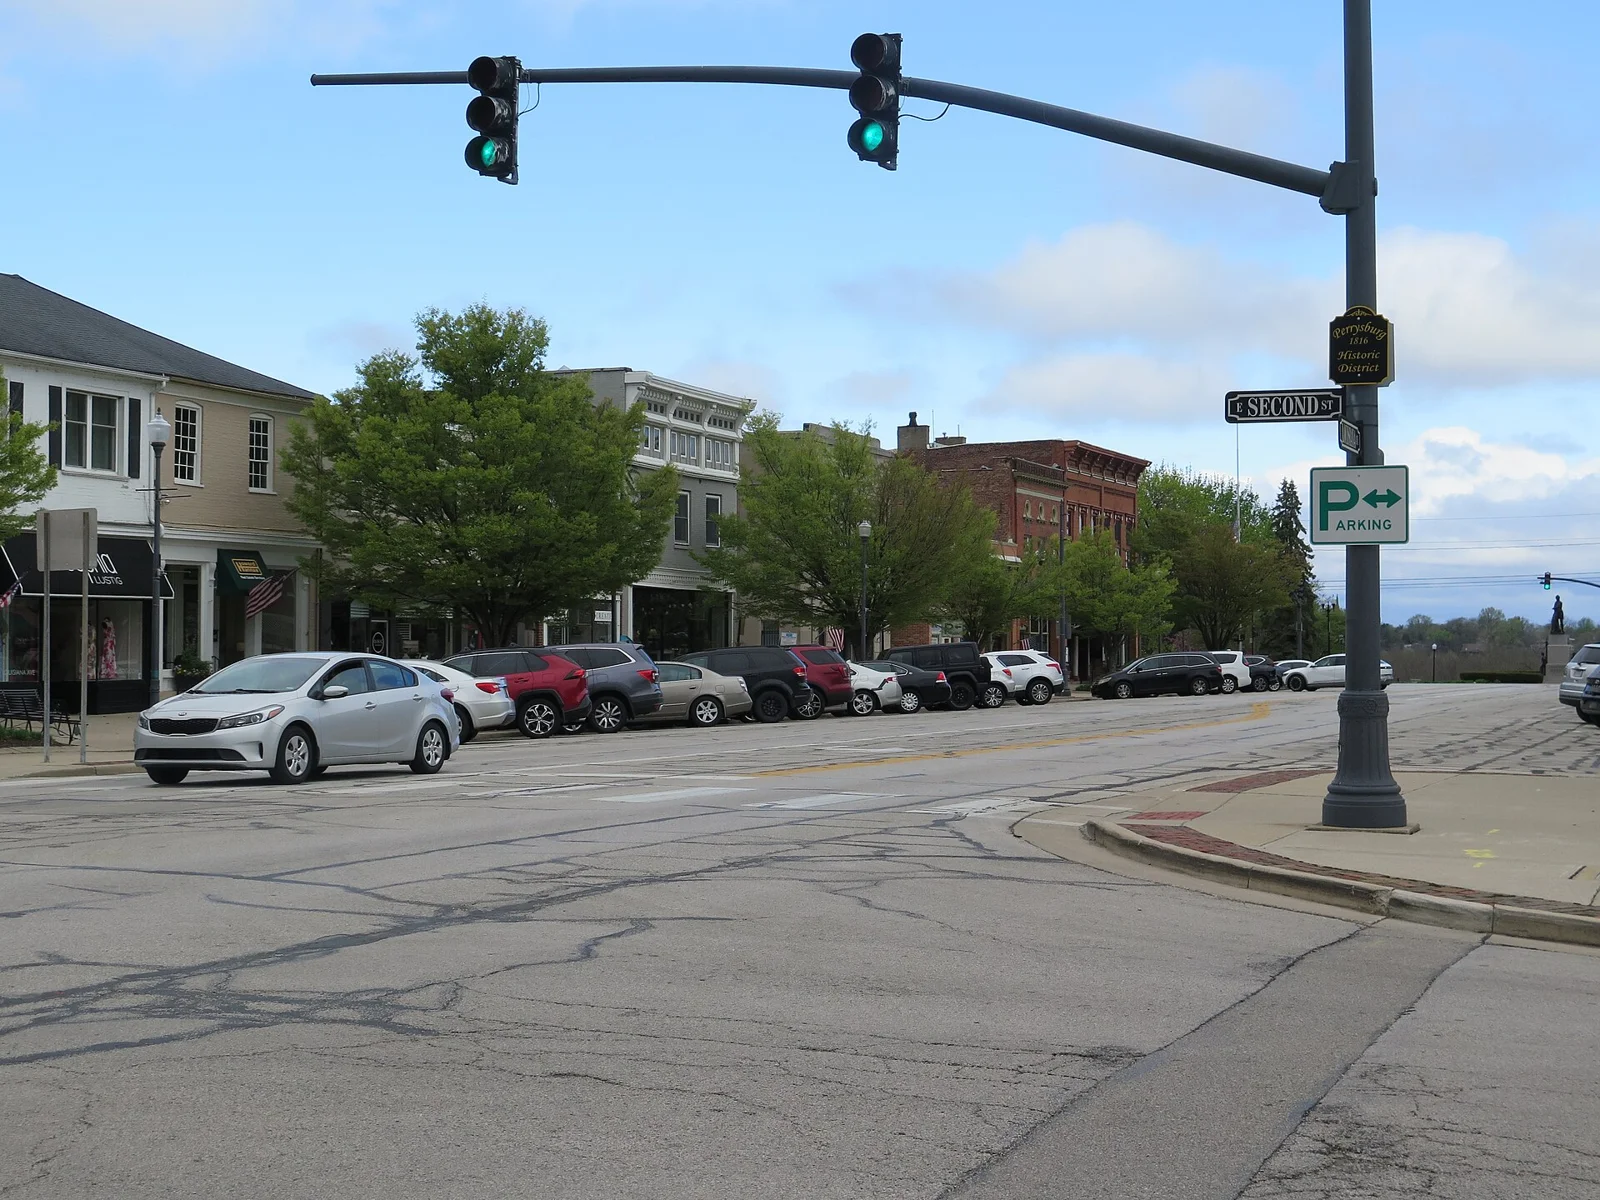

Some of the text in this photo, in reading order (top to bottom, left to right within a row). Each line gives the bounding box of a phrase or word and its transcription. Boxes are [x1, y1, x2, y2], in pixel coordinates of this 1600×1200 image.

[1333, 321, 1387, 340] Perrysburg
[1350, 337, 1369, 345] 1816
[1337, 350, 1380, 360] Historic
[1338, 363, 1380, 372] District
[1236, 396, 1334, 417] E SECOND ST
[94, 576, 123, 585] LUSTIG
